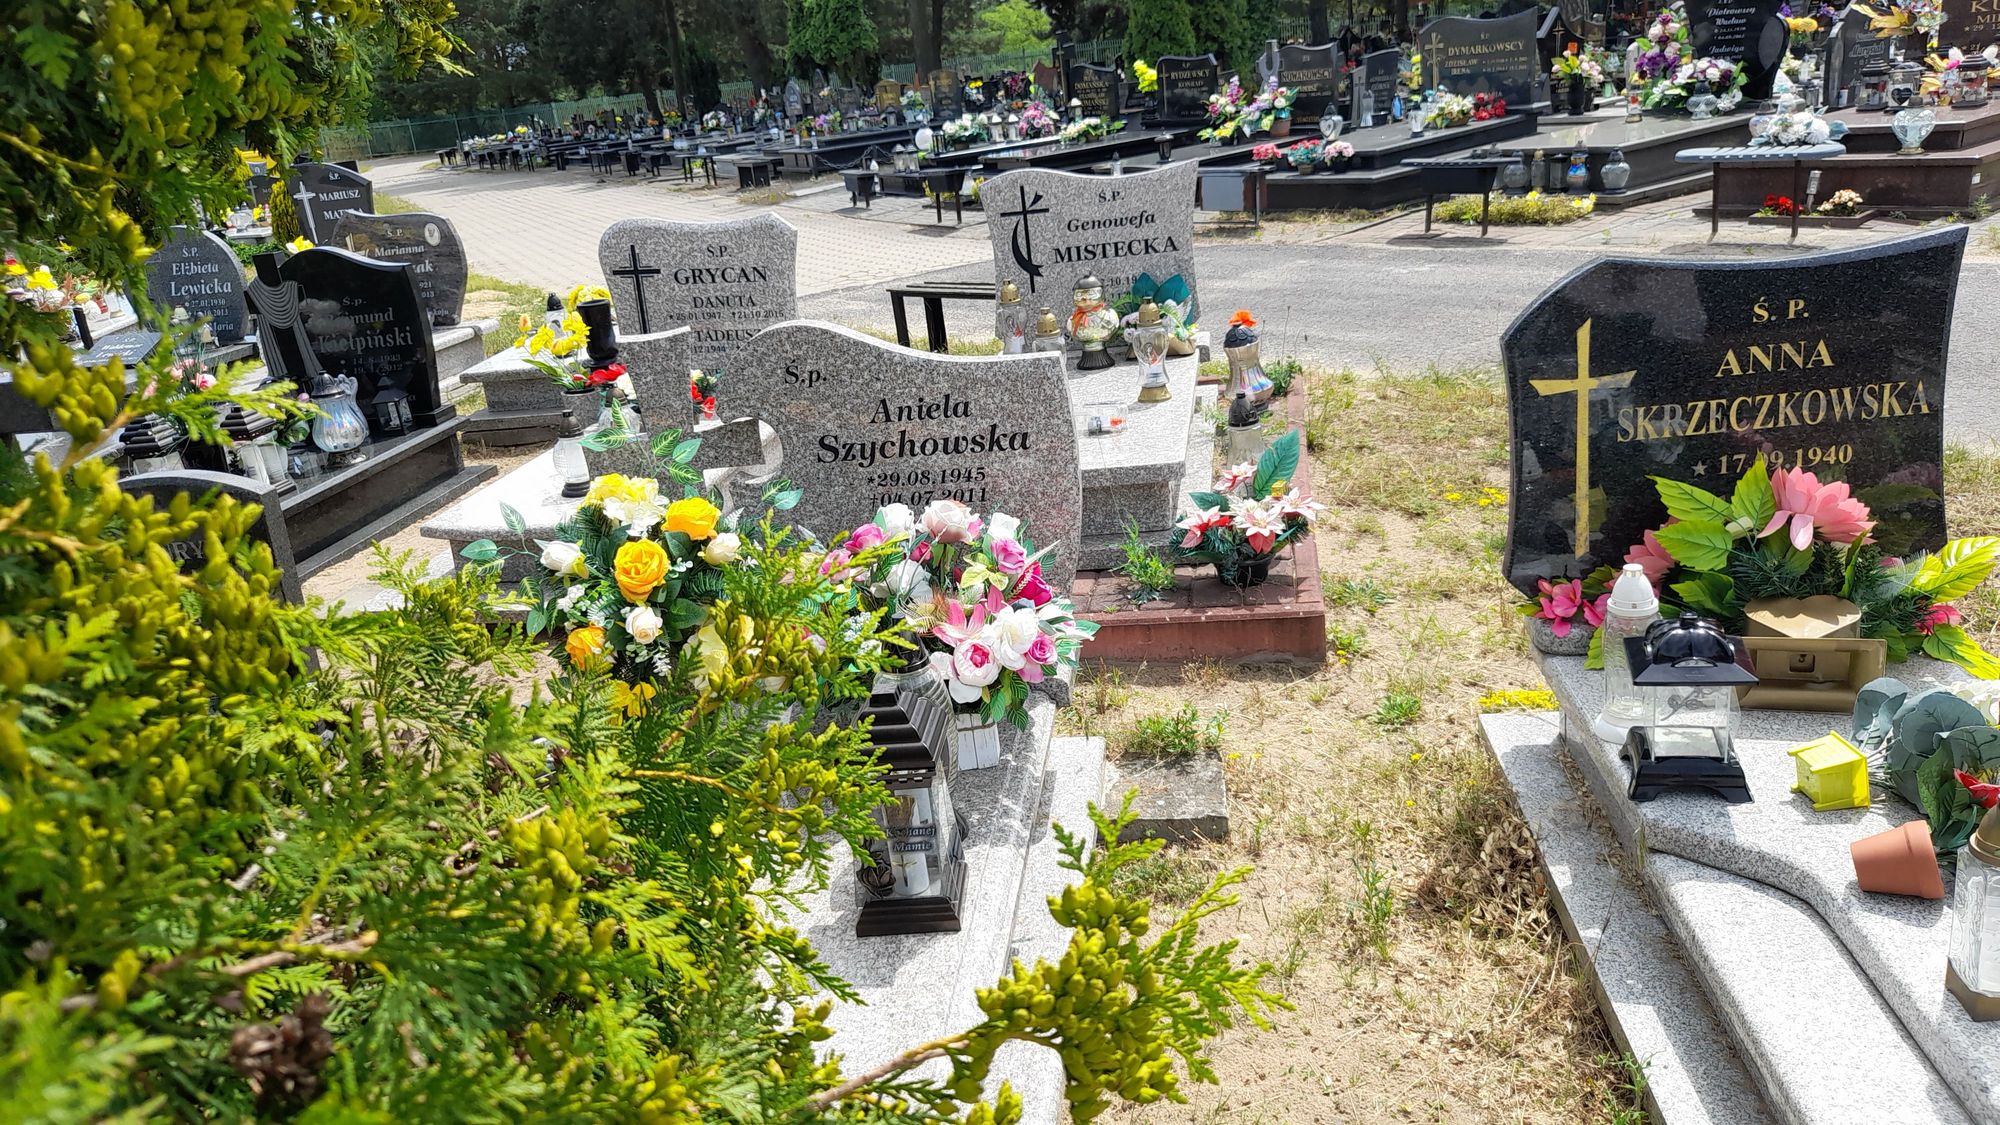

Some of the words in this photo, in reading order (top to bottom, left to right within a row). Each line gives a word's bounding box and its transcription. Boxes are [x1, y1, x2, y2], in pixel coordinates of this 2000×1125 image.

[1448, 40, 1525, 57] DYMARKOWSCY
[319, 189, 361, 202] MARIUSZ
[1098, 190, 1125, 203] Ś.P.
[1067, 210, 1156, 233] Genowefa
[374, 245, 425, 257] Marianna
[1054, 235, 1180, 264] MISTECKA
[172, 262, 219, 277] Elżbieta
[674, 266, 768, 286] GRYCAN
[170, 278, 232, 297] Lewicka
[693, 295, 757, 309] DANUTA
[1715, 338, 1836, 377] ANNA
[784, 358, 827, 390] Ś.p.
[869, 393, 972, 425] Aniela
[1616, 380, 1931, 443] SKRZECZKOWSKA
[817, 423, 1032, 468] Szychowska
[894, 841, 932, 851] Mamie
